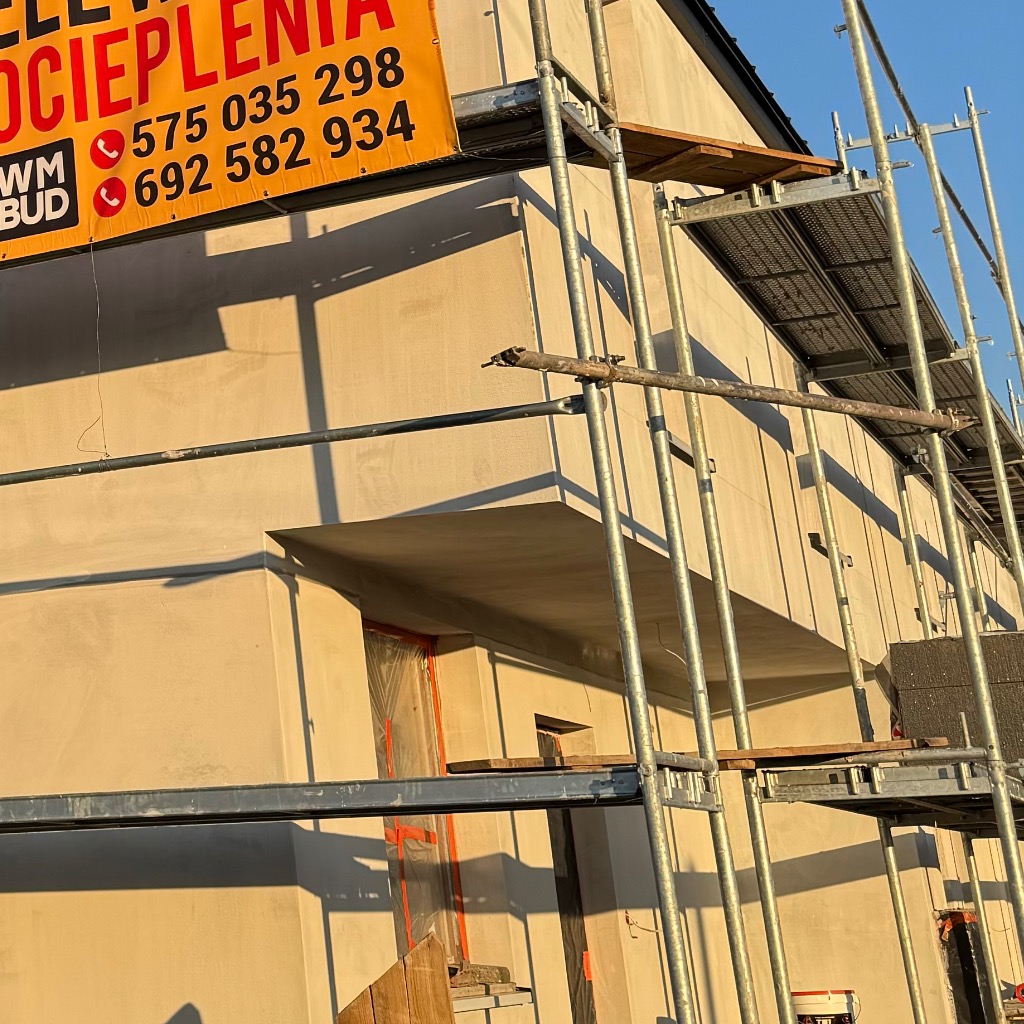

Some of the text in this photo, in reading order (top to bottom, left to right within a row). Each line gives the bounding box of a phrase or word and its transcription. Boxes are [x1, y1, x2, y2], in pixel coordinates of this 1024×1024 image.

[132, 46, 405, 158] 575 035 298
[134, 99, 416, 208] 692 582 934
